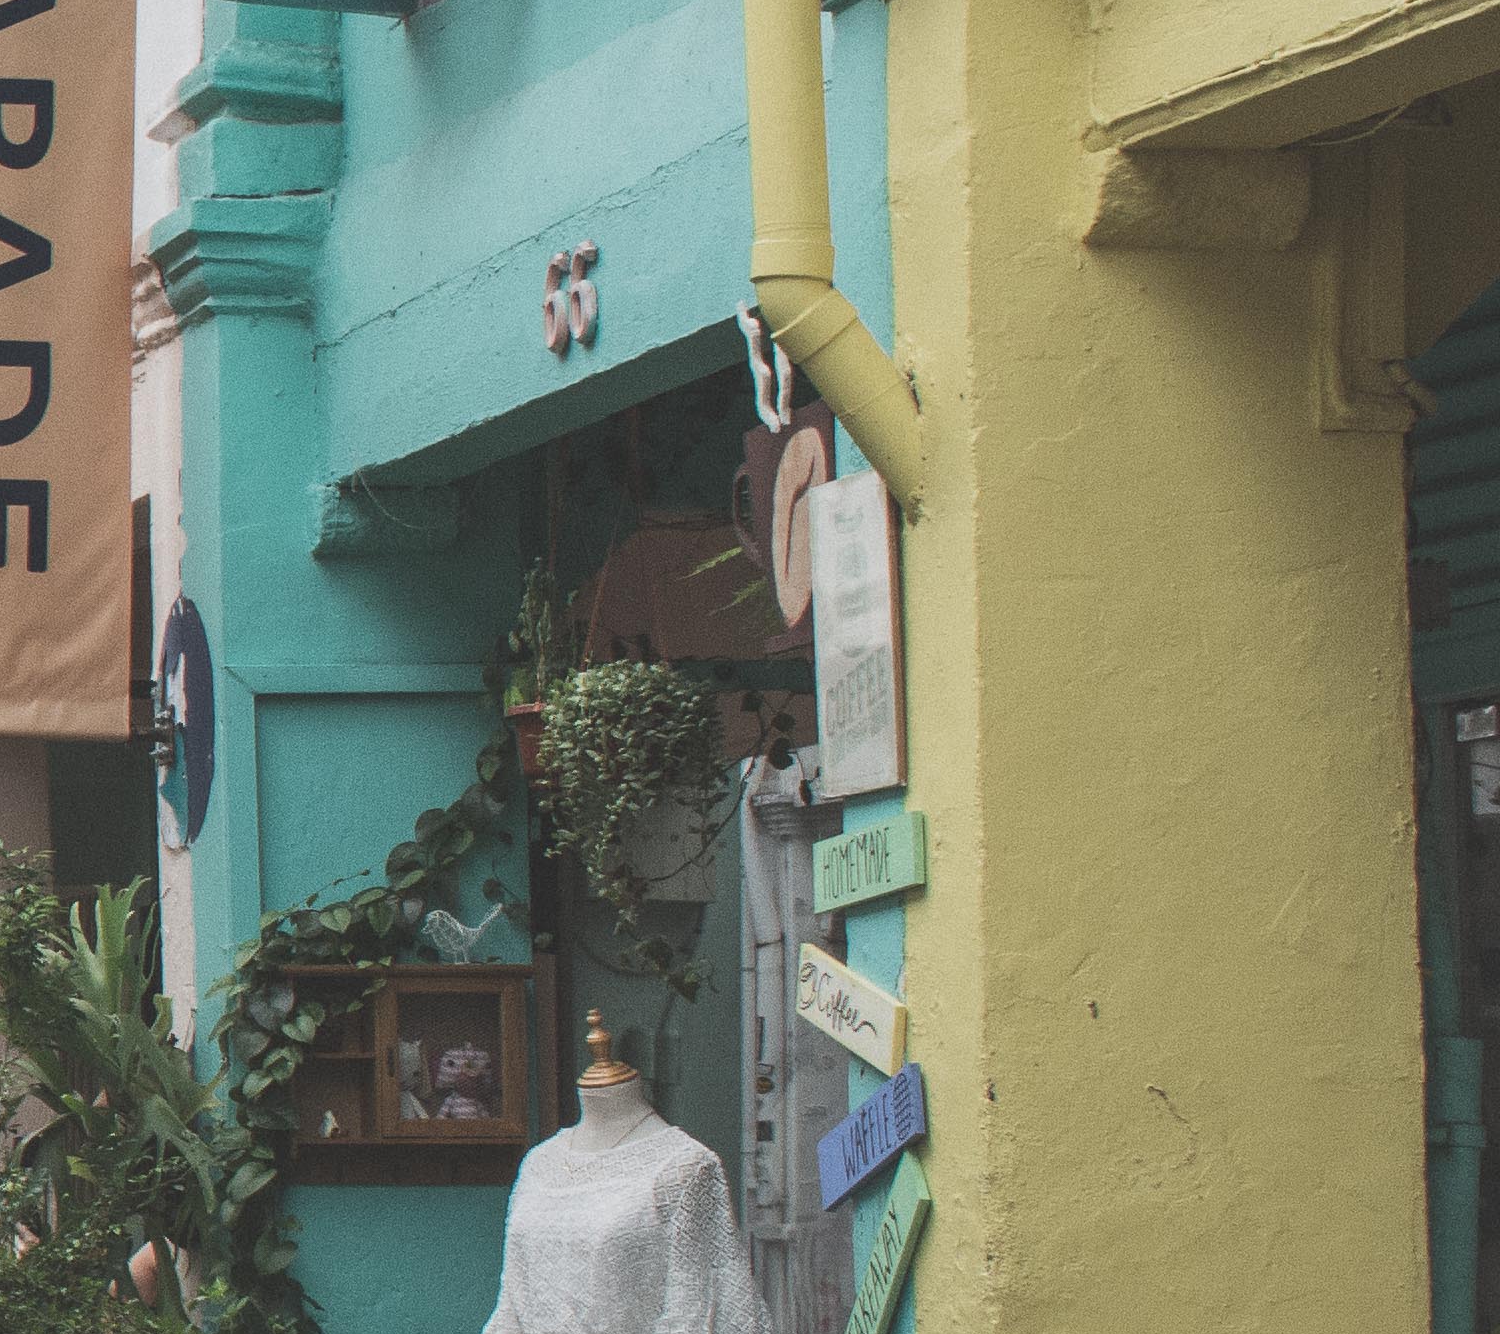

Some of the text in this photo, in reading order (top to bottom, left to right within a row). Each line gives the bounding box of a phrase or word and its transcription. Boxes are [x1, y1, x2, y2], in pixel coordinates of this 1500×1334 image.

[544, 240, 597, 359] 66
[825, 645, 888, 739] COFFEE
[822, 827, 891, 901] HOMEMADE
[816, 972, 878, 1034] Coffee
[841, 1092, 893, 1183] WAFFLE
